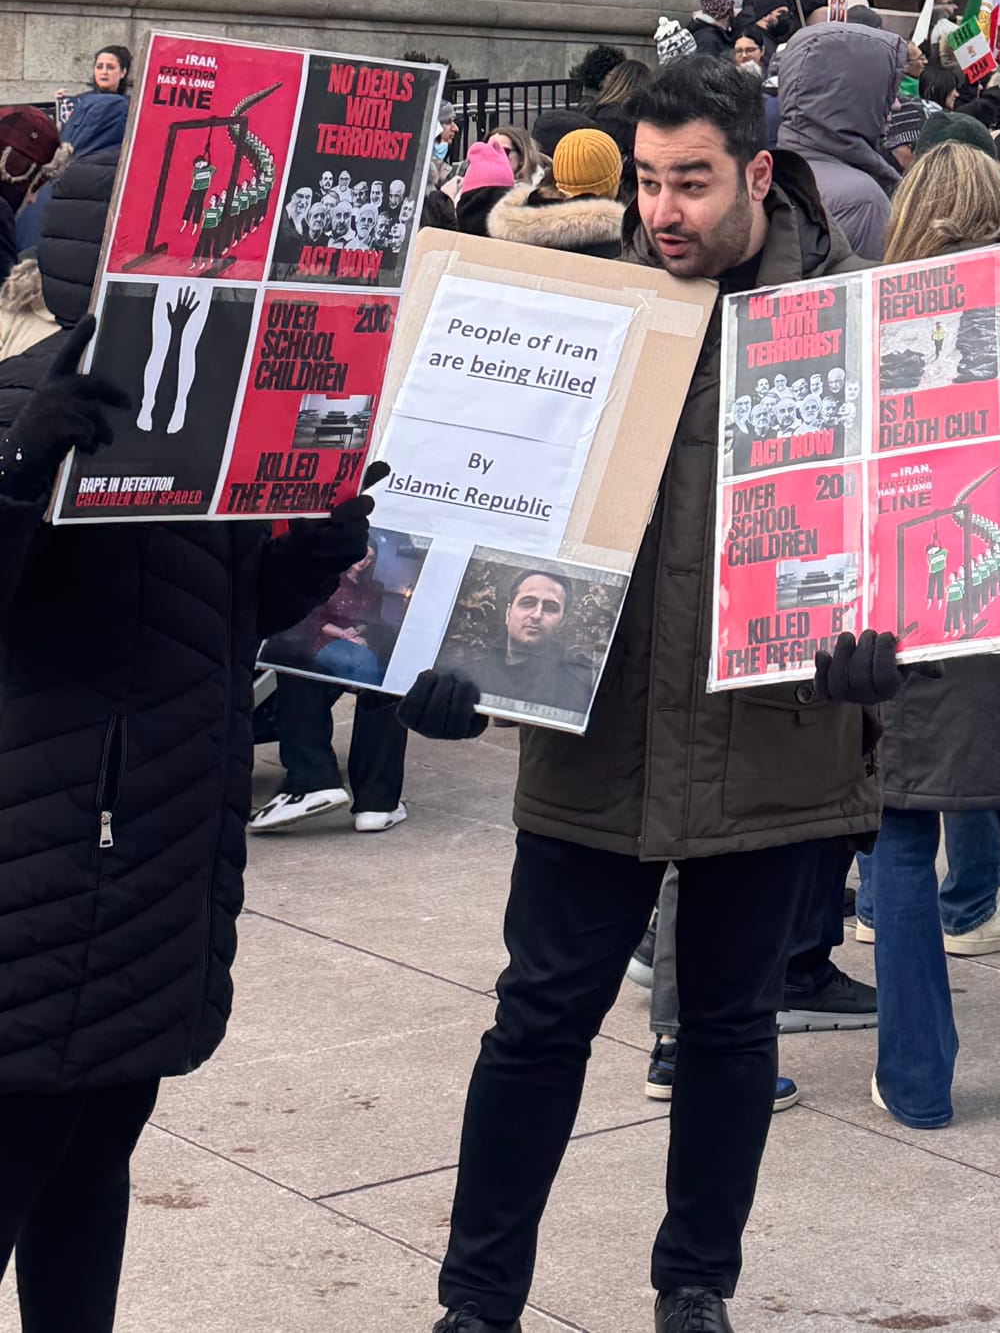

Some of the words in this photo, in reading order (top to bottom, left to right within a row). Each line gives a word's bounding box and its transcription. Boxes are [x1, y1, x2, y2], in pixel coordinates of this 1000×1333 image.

[185, 54, 218, 69] IRAN,
[152, 85, 212, 110] LINE
[157, 74, 176, 84] HAS
[180, 77, 186, 85] A
[189, 78, 215, 88] LONG
[327, 64, 353, 96] NO
[355, 69, 415, 101] DEALS
[348, 94, 391, 131] WITH
[316, 124, 413, 161] TERRORIST
[298, 246, 335, 277] ACT
[337, 248, 384, 280] NOW
[879, 264, 957, 298] ISLAMIC
[267, 300, 320, 329] OVER
[750, 296, 774, 320] NO
[775, 287, 836, 317] DEALS
[879, 282, 966, 320] REPUBLIC
[447, 318, 522, 347] People
[527, 333, 553, 351] of
[556, 337, 598, 362] Iran
[771, 312, 818, 341] WITH
[261, 331, 335, 363] SCHOOL
[746, 329, 842, 368] TERRORIST
[254, 363, 349, 393] CHILDREN
[429, 351, 465, 372] are
[469, 354, 530, 386] being
[536, 366, 596, 395] killed
[879, 397, 897, 425] IS
[899, 396, 916, 421] A
[879, 418, 938, 449] DEATH
[944, 409, 990, 440] CULT
[468, 452, 492, 475] By
[750, 438, 787, 467] ACT
[789, 430, 835, 460] NOW
[255, 453, 319, 481] KILLED
[334, 452, 363, 481] BY
[75, 492, 131, 507] CHILDREN
[134, 491, 156, 506] NOT
[159, 490, 202, 505] SPARED
[79, 477, 108, 493] RAPE
[108, 477, 120, 492] IN
[120, 476, 174, 492] DETENTION
[226, 483, 266, 512] THE
[265, 482, 342, 512] REGIME
[388, 473, 459, 502] Islamic
[464, 488, 554, 518] Republic
[731, 482, 776, 515] OVER
[815, 473, 856, 502] 200
[907, 482, 933, 492] LONG
[878, 491, 931, 514] LINE
[729, 505, 801, 542] SCHOOL
[727, 528, 818, 567] CHILDREN
[747, 611, 809, 645] KILLED
[725, 646, 761, 676] THE
[766, 632, 838, 671] REGIM
